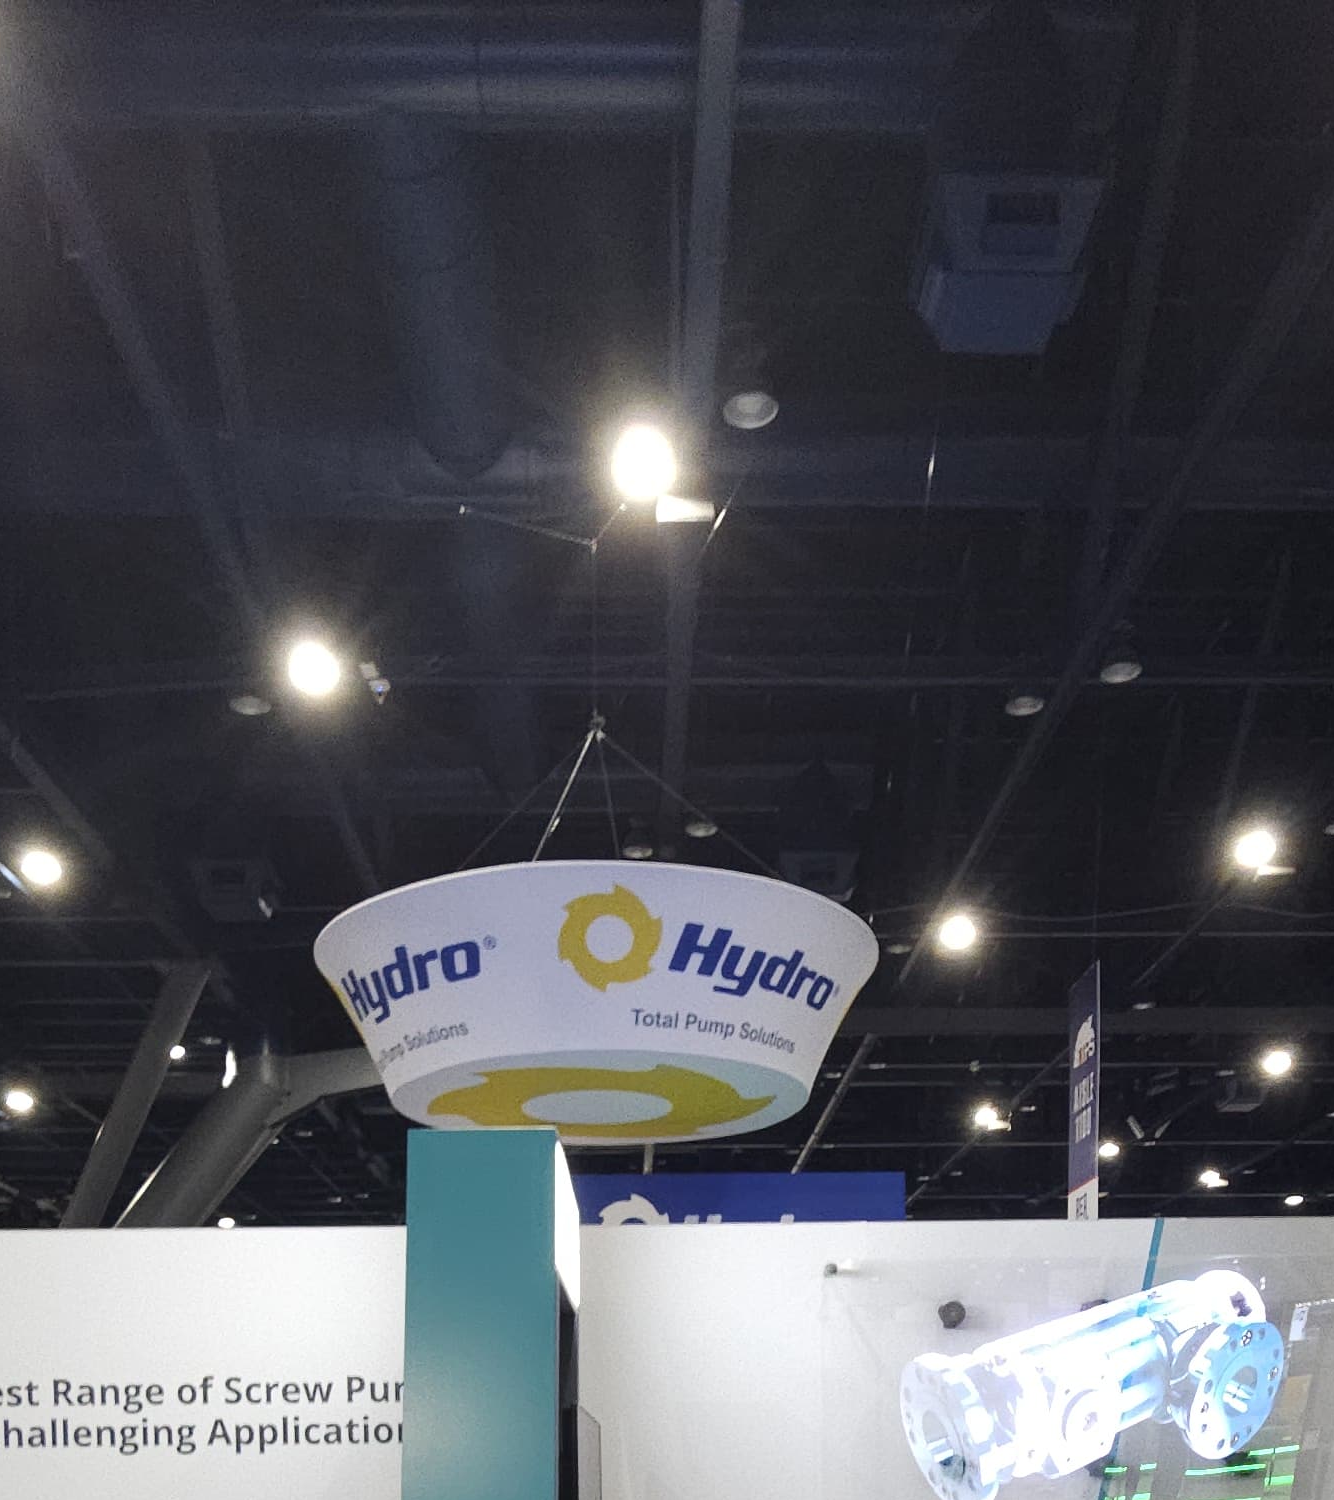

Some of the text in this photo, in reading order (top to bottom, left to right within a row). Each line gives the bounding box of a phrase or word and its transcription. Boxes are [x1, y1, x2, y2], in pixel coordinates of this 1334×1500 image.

[403, 1021, 469, 1051] Solutions
[631, 1008, 796, 1053] Total Pump Solutions
[54, 1378, 165, 1414] Range
[177, 1375, 215, 1405] of
[224, 1375, 333, 1404] Screw
